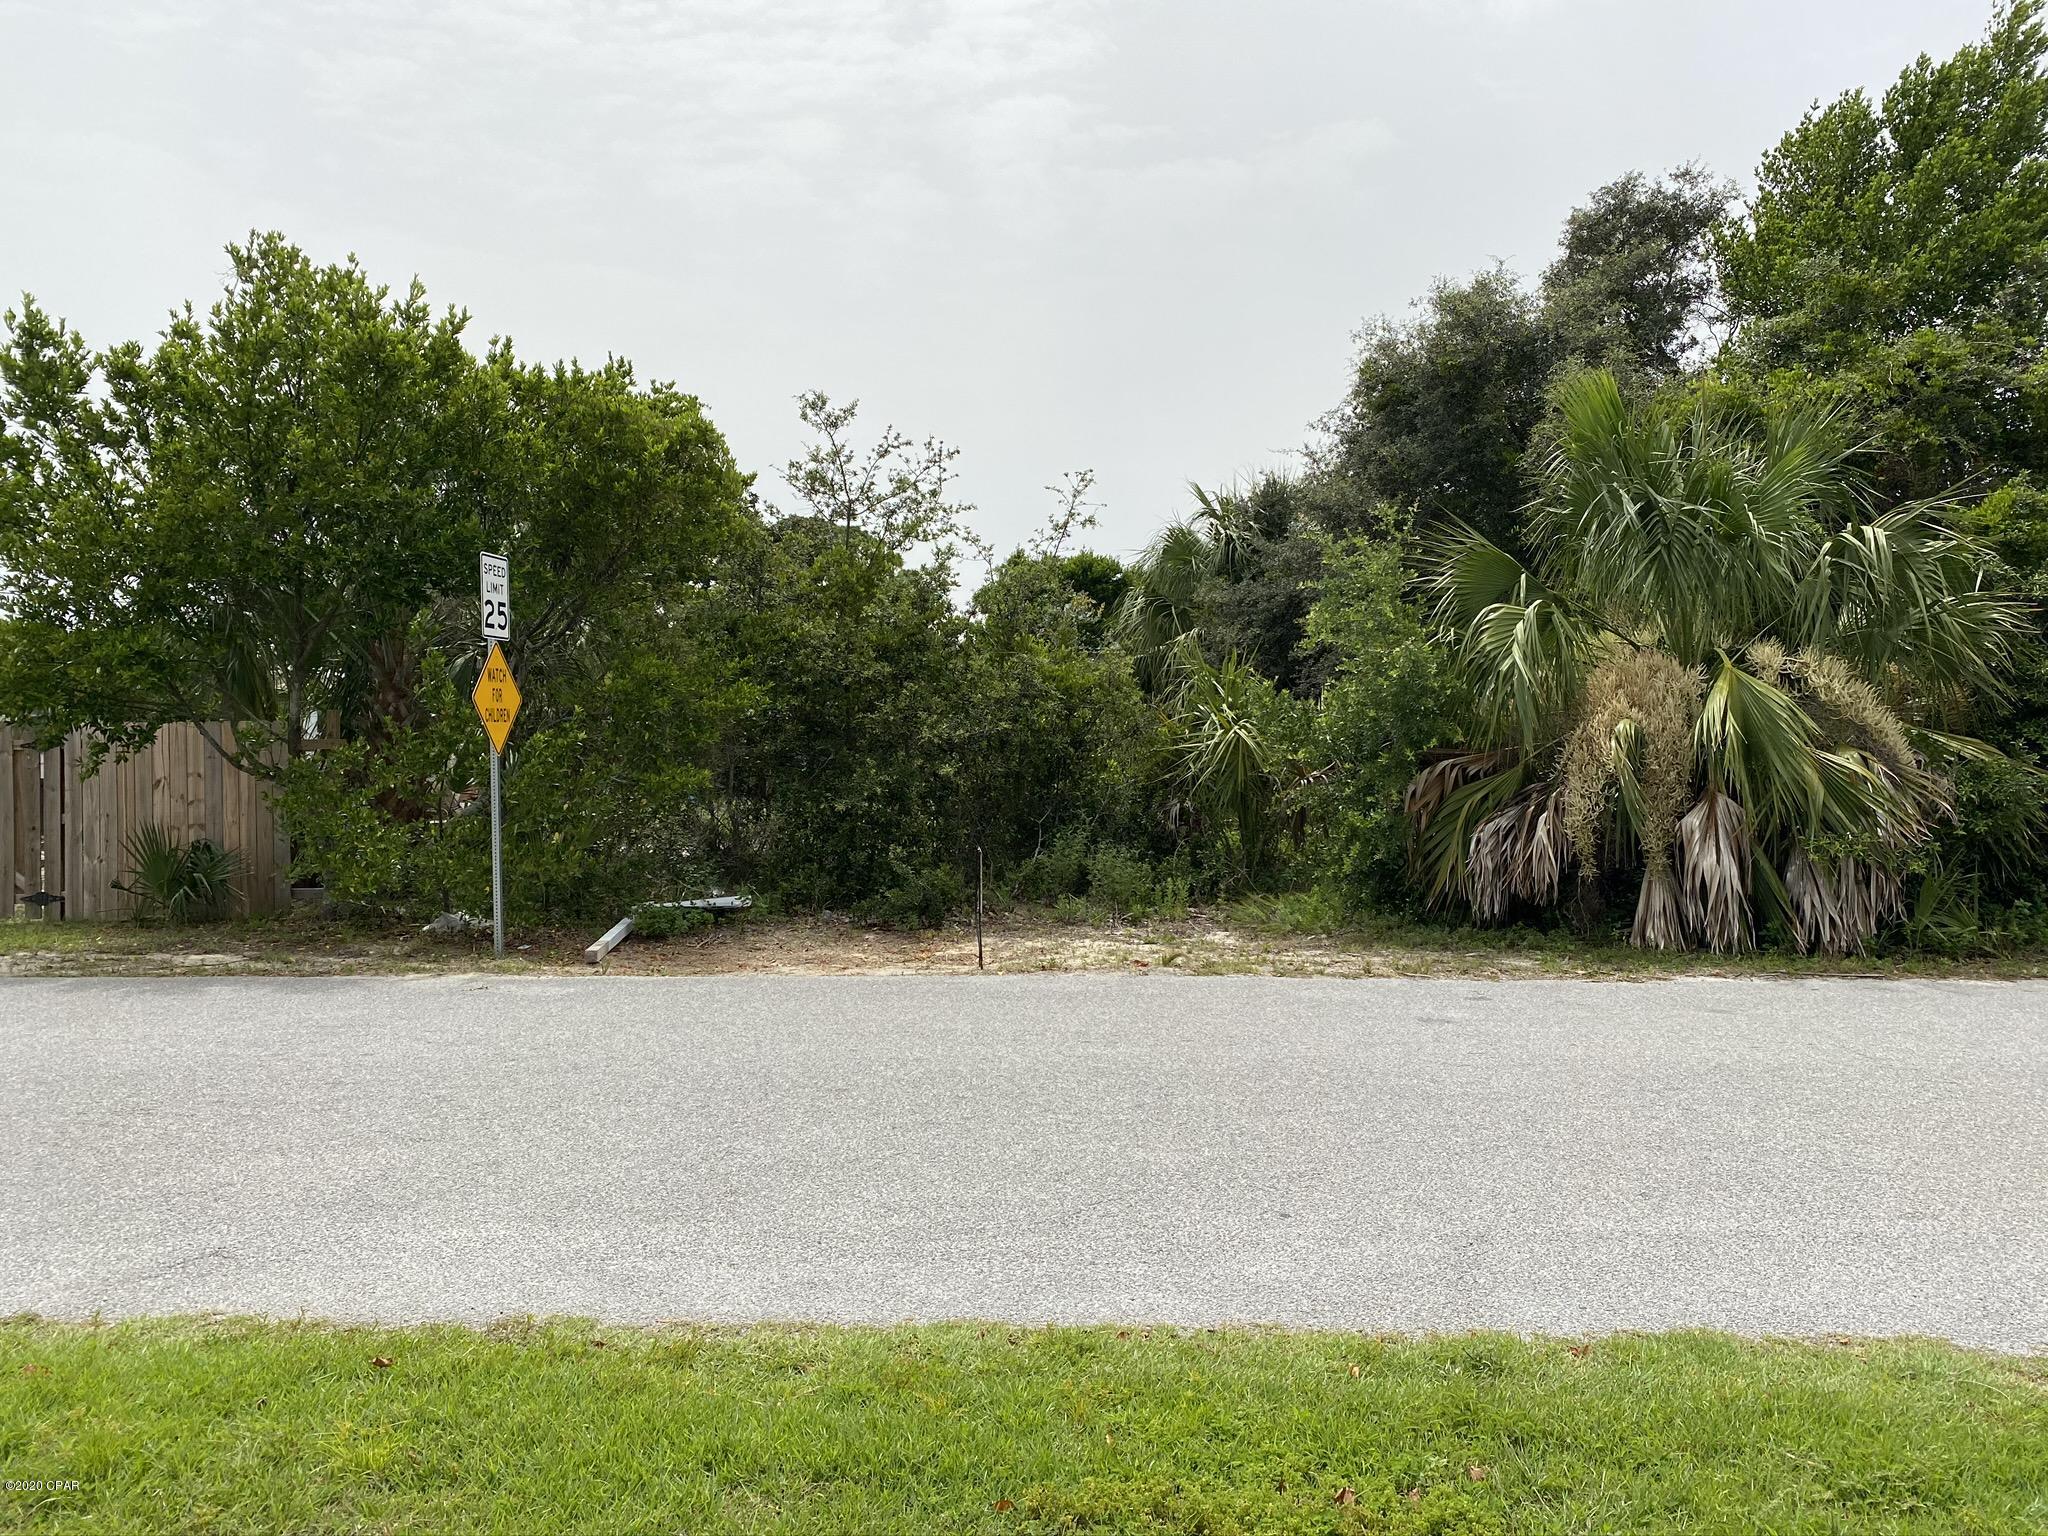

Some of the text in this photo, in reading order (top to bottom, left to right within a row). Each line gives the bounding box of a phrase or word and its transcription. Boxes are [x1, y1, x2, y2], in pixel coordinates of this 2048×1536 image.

[483, 562, 506, 579] SPEED
[486, 581, 504, 596] LIMIT
[485, 599, 508, 631] 25
[487, 667, 507, 683] WATCH
[492, 688, 503, 703] FOR
[485, 707, 511, 723] CHILDREN
